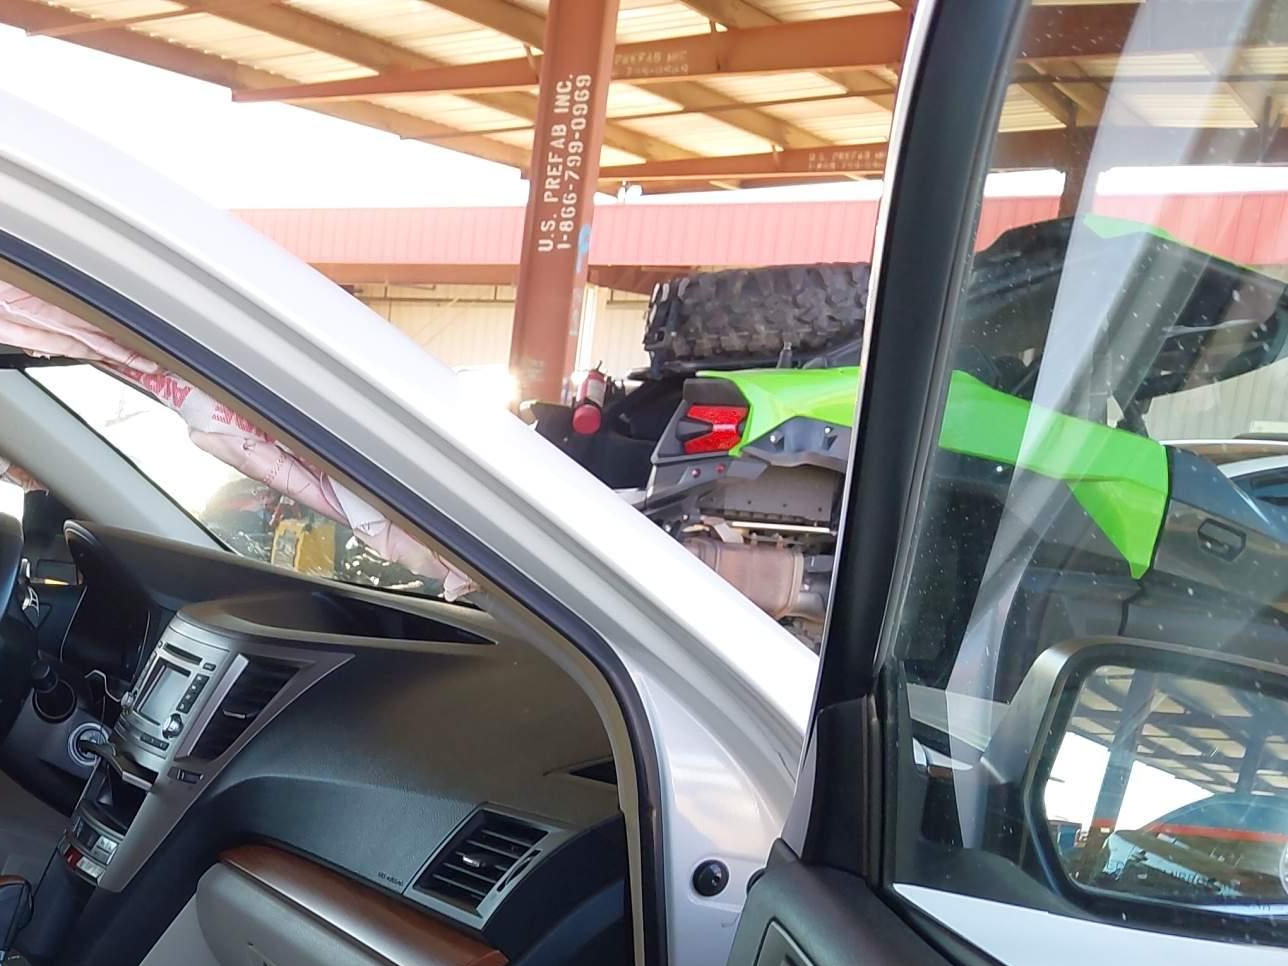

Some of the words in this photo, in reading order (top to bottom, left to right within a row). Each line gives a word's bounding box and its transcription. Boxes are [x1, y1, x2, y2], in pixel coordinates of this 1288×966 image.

[553, 73, 574, 114] INC.
[543, 124, 568, 203] PREFAB
[556, 74, 592, 250] 1-866-799-0969
[538, 213, 557, 252] U.S.
